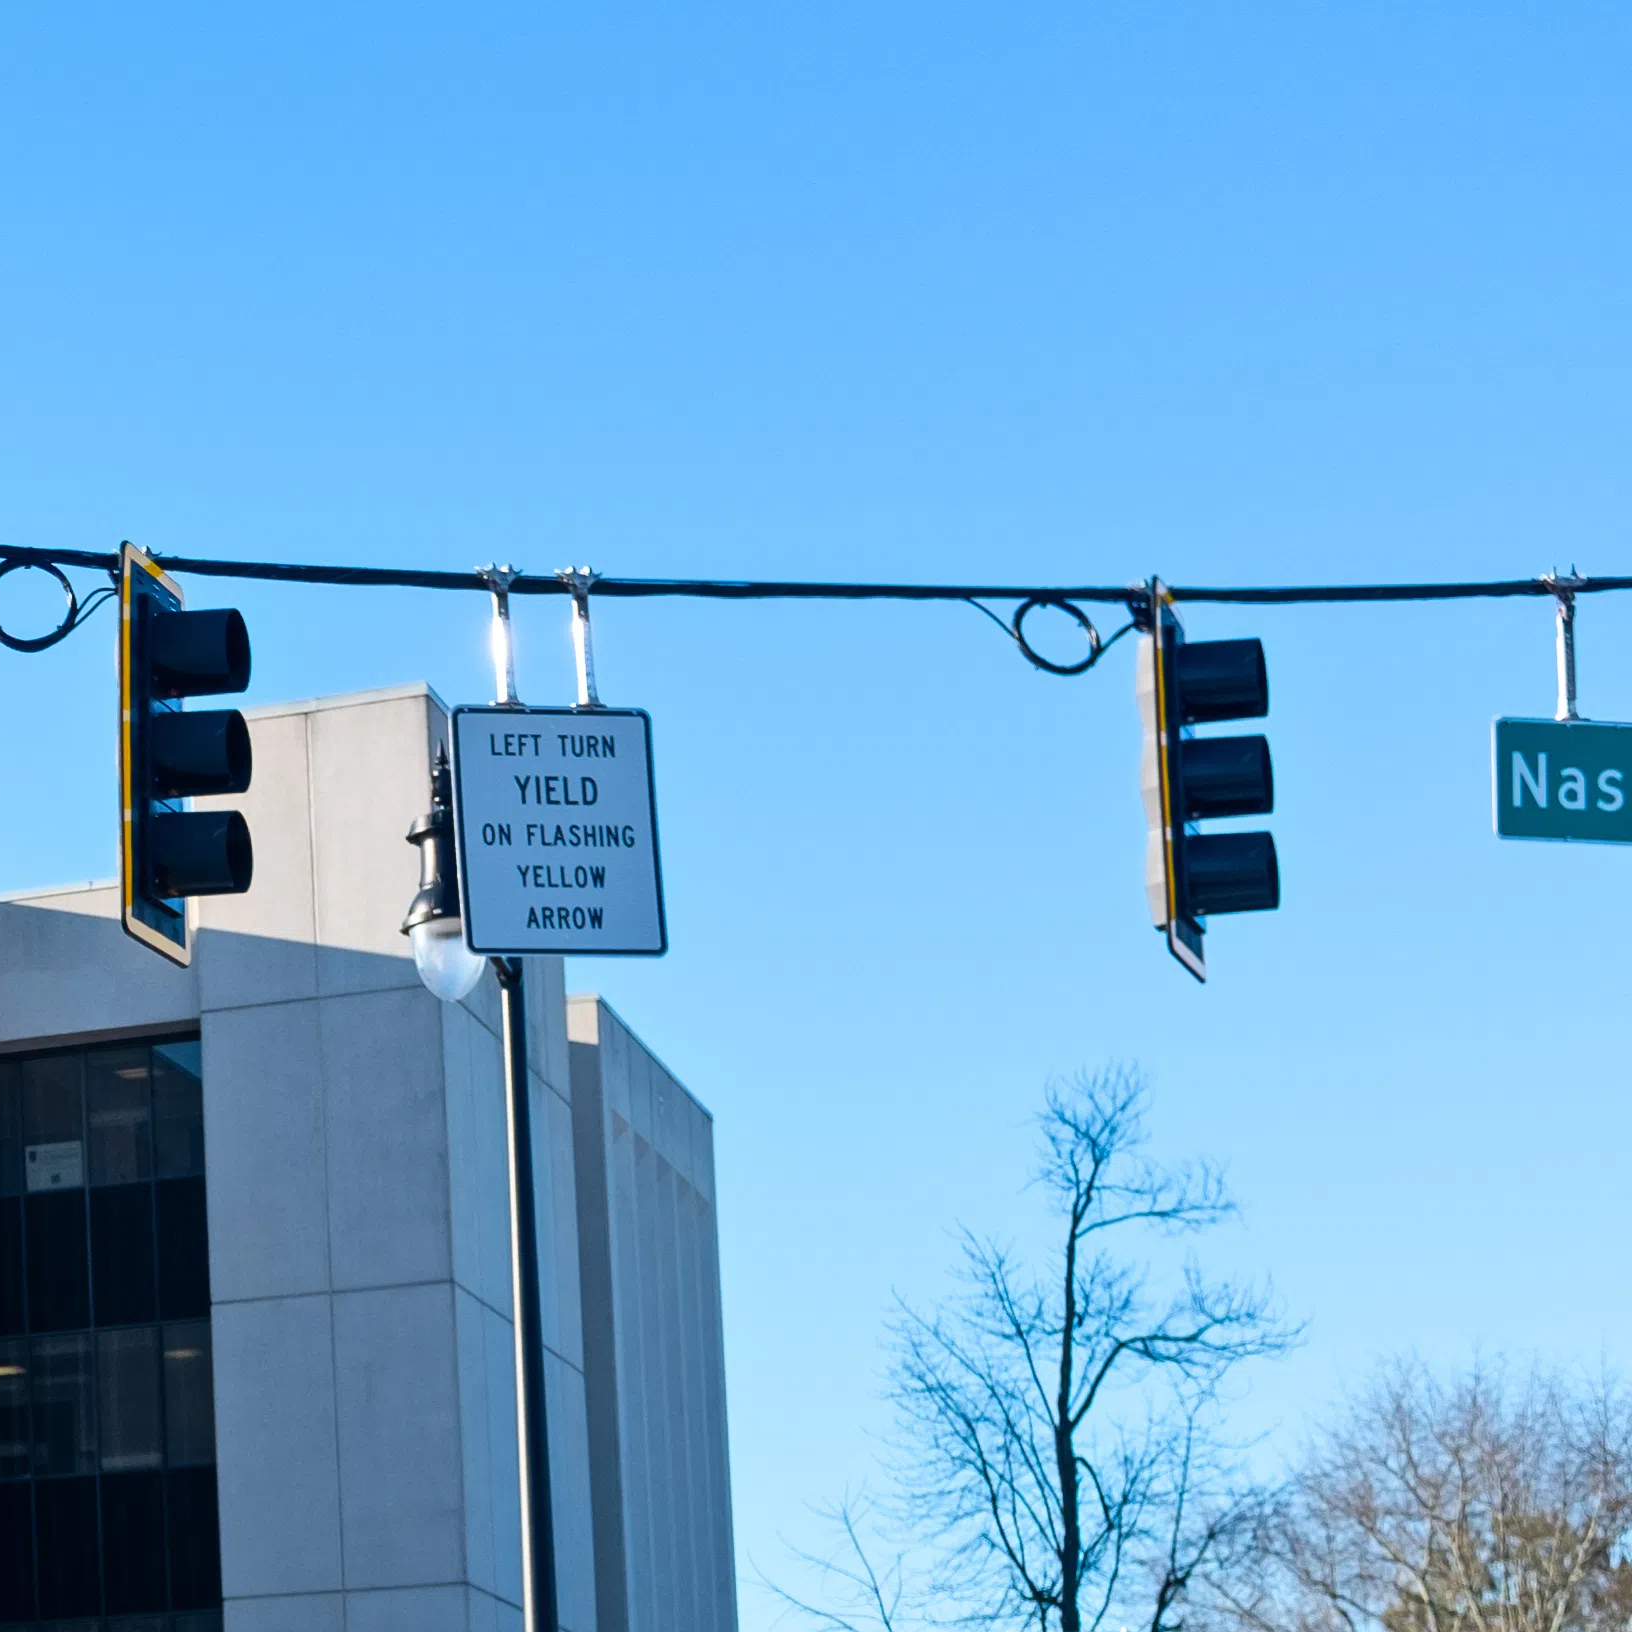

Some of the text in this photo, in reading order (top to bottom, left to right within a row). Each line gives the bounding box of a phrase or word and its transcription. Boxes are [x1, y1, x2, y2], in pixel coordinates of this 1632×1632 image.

[490, 733, 616, 758] LEFT TURN
[513, 775, 599, 806] YIELD
[1511, 750, 1625, 812] Nas
[481, 823, 635, 848] ON FLASHING
[516, 865, 606, 888] YELLOW
[526, 907, 604, 930] ARROW
